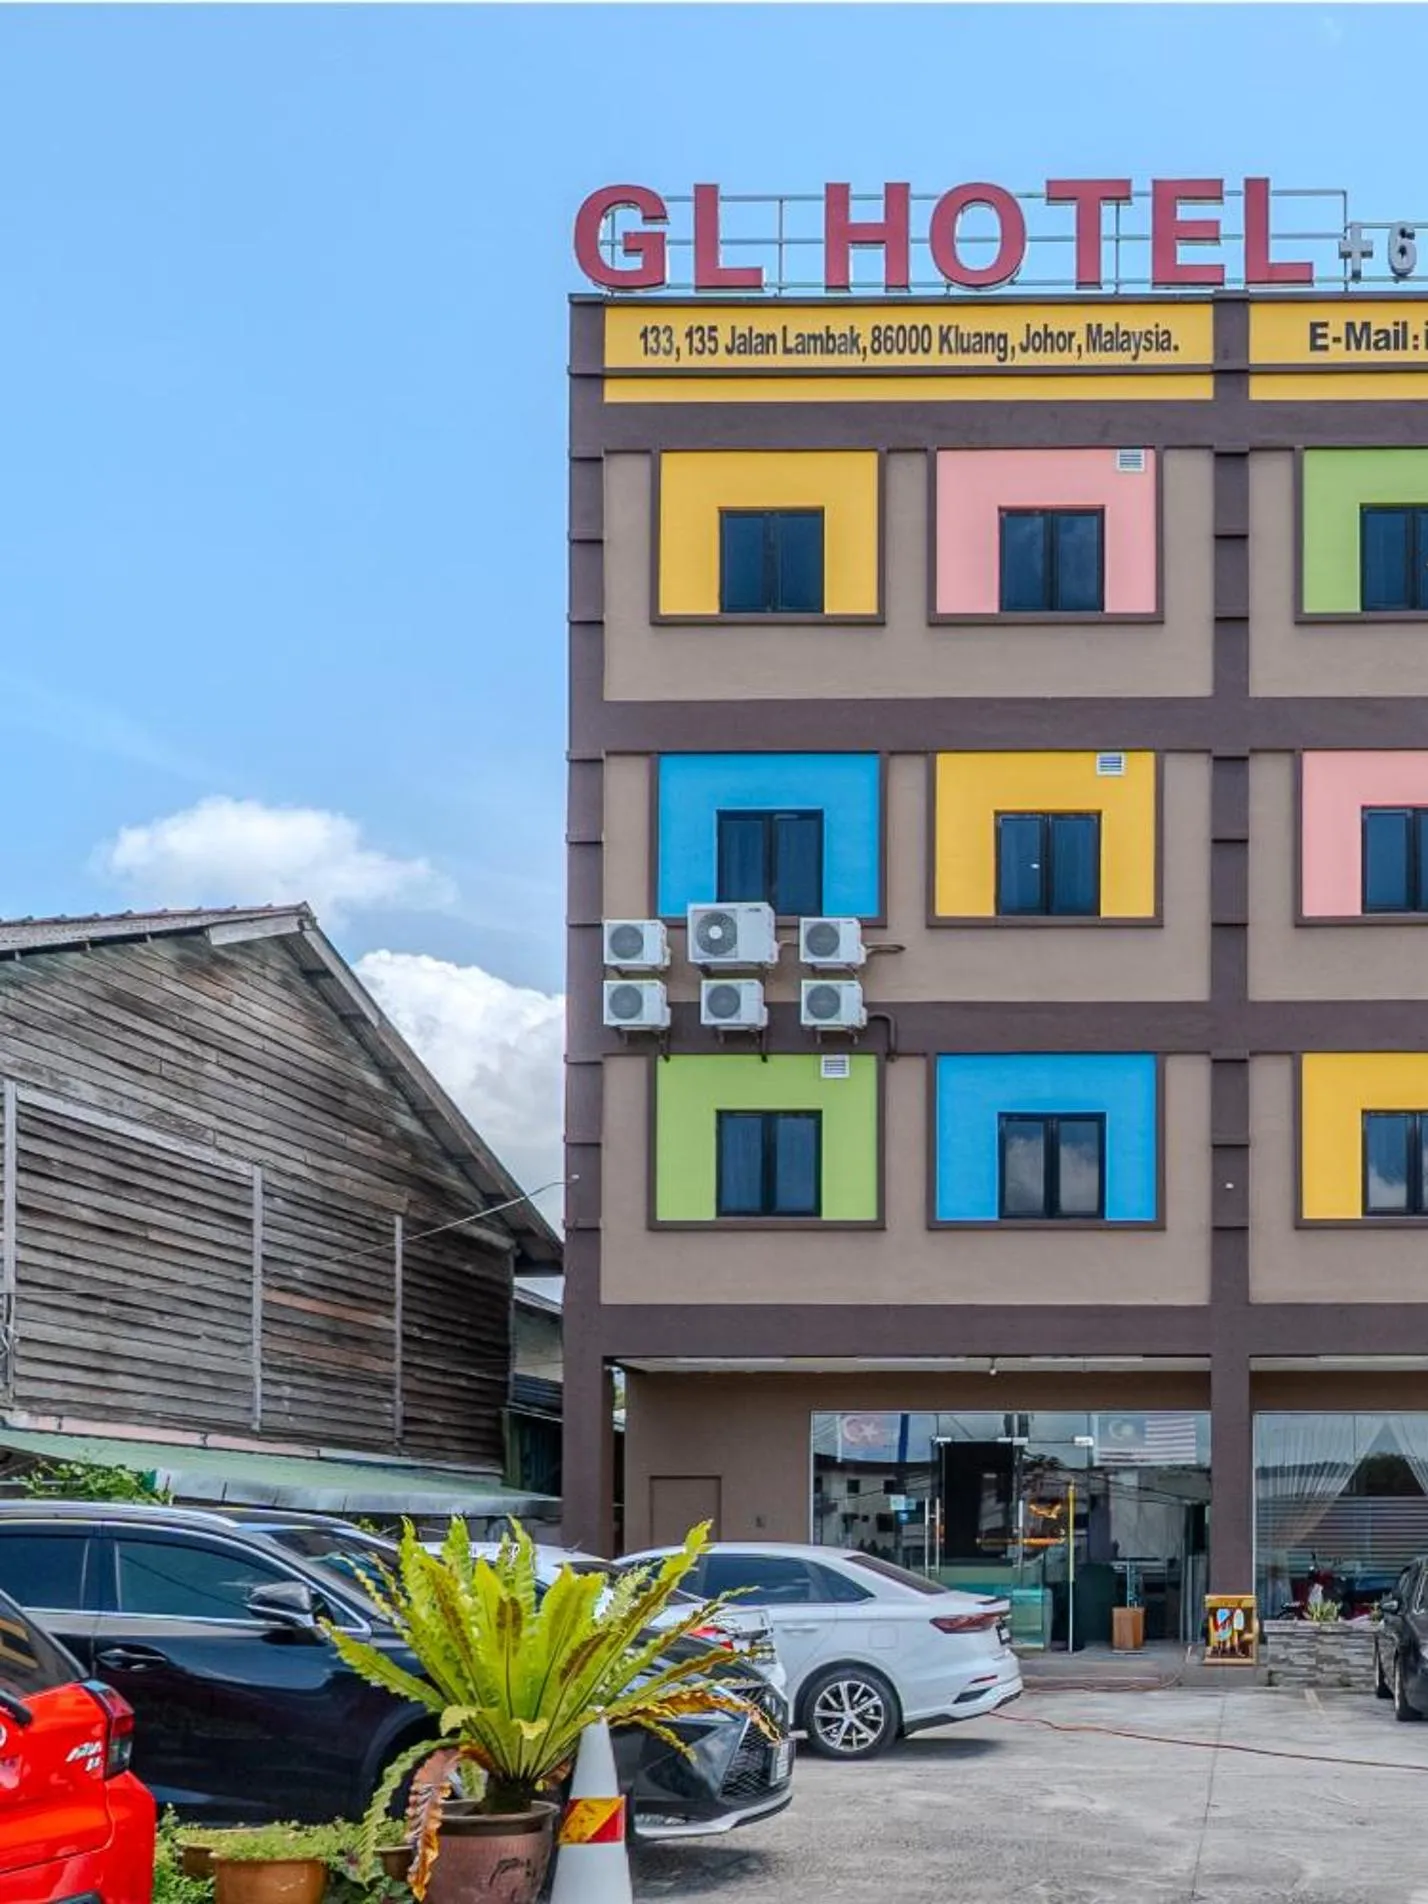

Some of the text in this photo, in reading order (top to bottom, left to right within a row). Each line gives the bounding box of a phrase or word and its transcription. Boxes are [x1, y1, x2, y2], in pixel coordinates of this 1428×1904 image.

[574, 177, 1314, 293] GL HOTEL
[685, 325, 718, 355] 135
[725, 324, 777, 356] Jalan
[870, 323, 932, 355] 86000
[1086, 322, 1180, 360] Malaysia.
